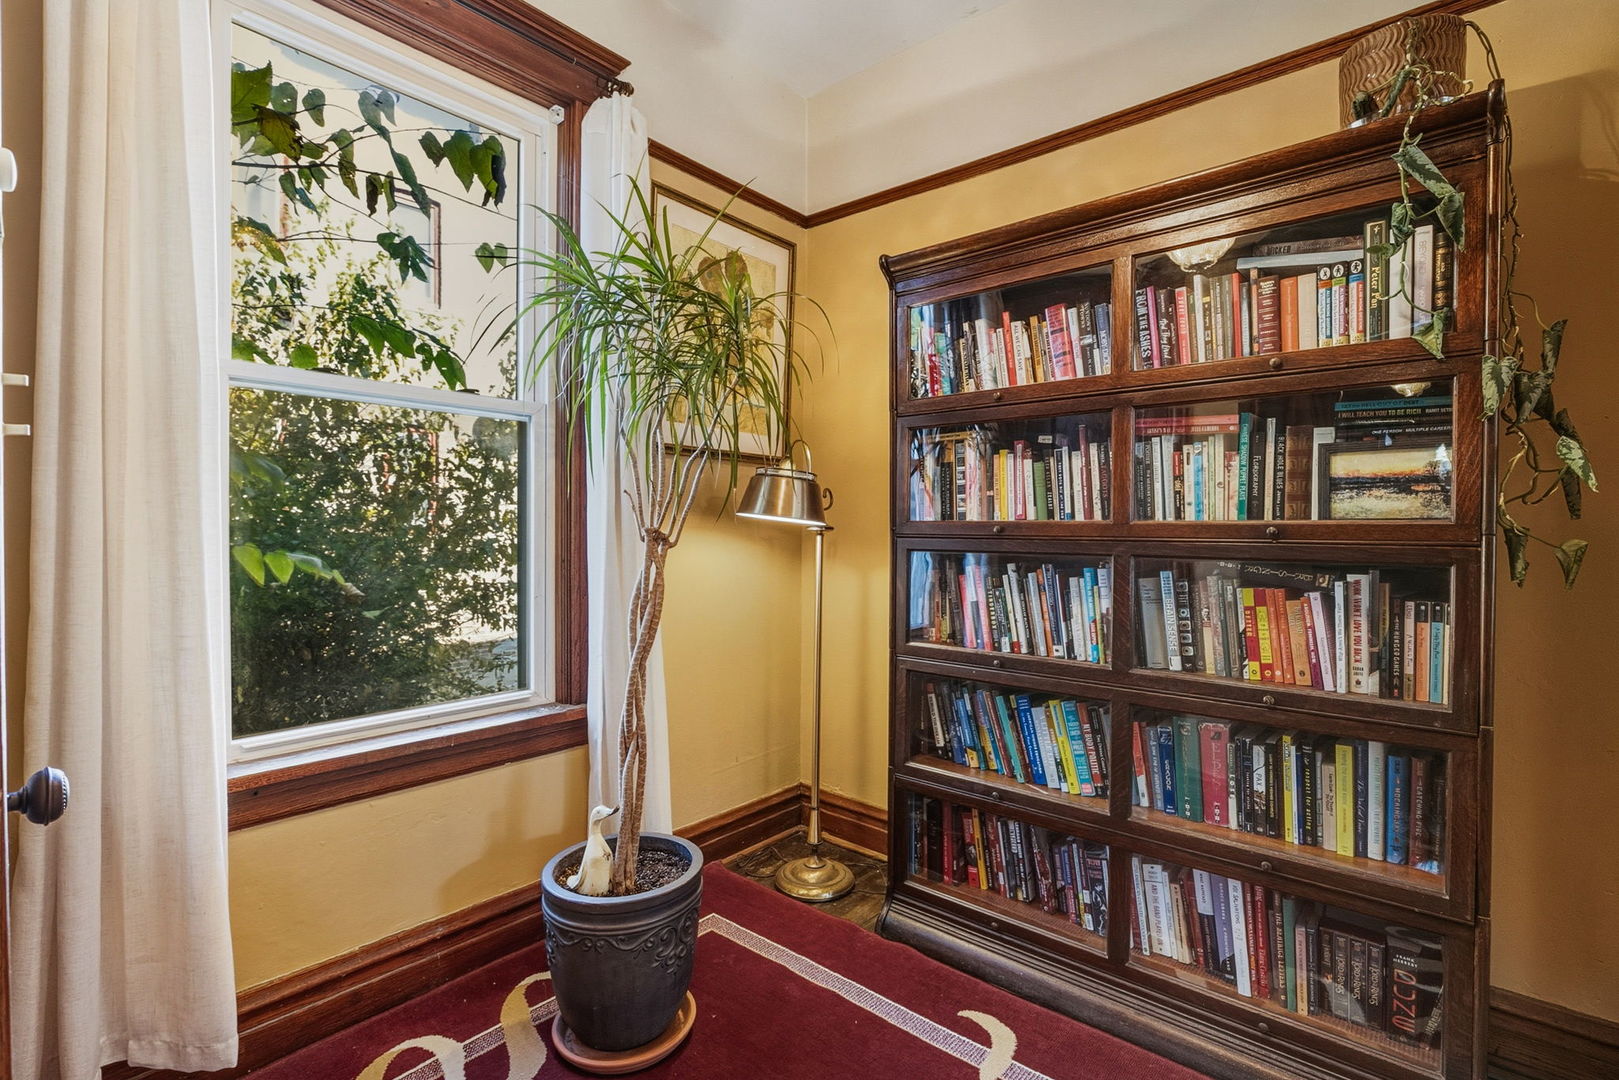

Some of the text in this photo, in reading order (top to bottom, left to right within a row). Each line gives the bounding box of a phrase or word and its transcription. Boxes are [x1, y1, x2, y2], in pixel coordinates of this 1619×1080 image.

[1369, 266, 1380, 308] Peter Pan
[1135, 288, 1152, 358] FROM THE ASHES
[1160, 330, 1171, 344] They
[1240, 423, 1249, 443] CHINESE
[1240, 444, 1249, 465] SHADOW
[1277, 436, 1285, 453] BLACK
[1239, 466, 1247, 484] PUPPET
[1276, 471, 1284, 489] BLUES
[1352, 579, 1362, 664] WORK WON'T LOVE YOU BACK
[1168, 624, 1177, 650] SENSE
[1083, 724, 1100, 775] MY BODY POLITIC
[1255, 773, 1263, 786] PAX
[1393, 787, 1401, 833] MOCKINGJAY
[1415, 786, 1423, 819] CATCHING
[1153, 905, 1161, 919] BAND
[1156, 938, 1163, 946] ON
[1395, 954, 1415, 963] FRANK
